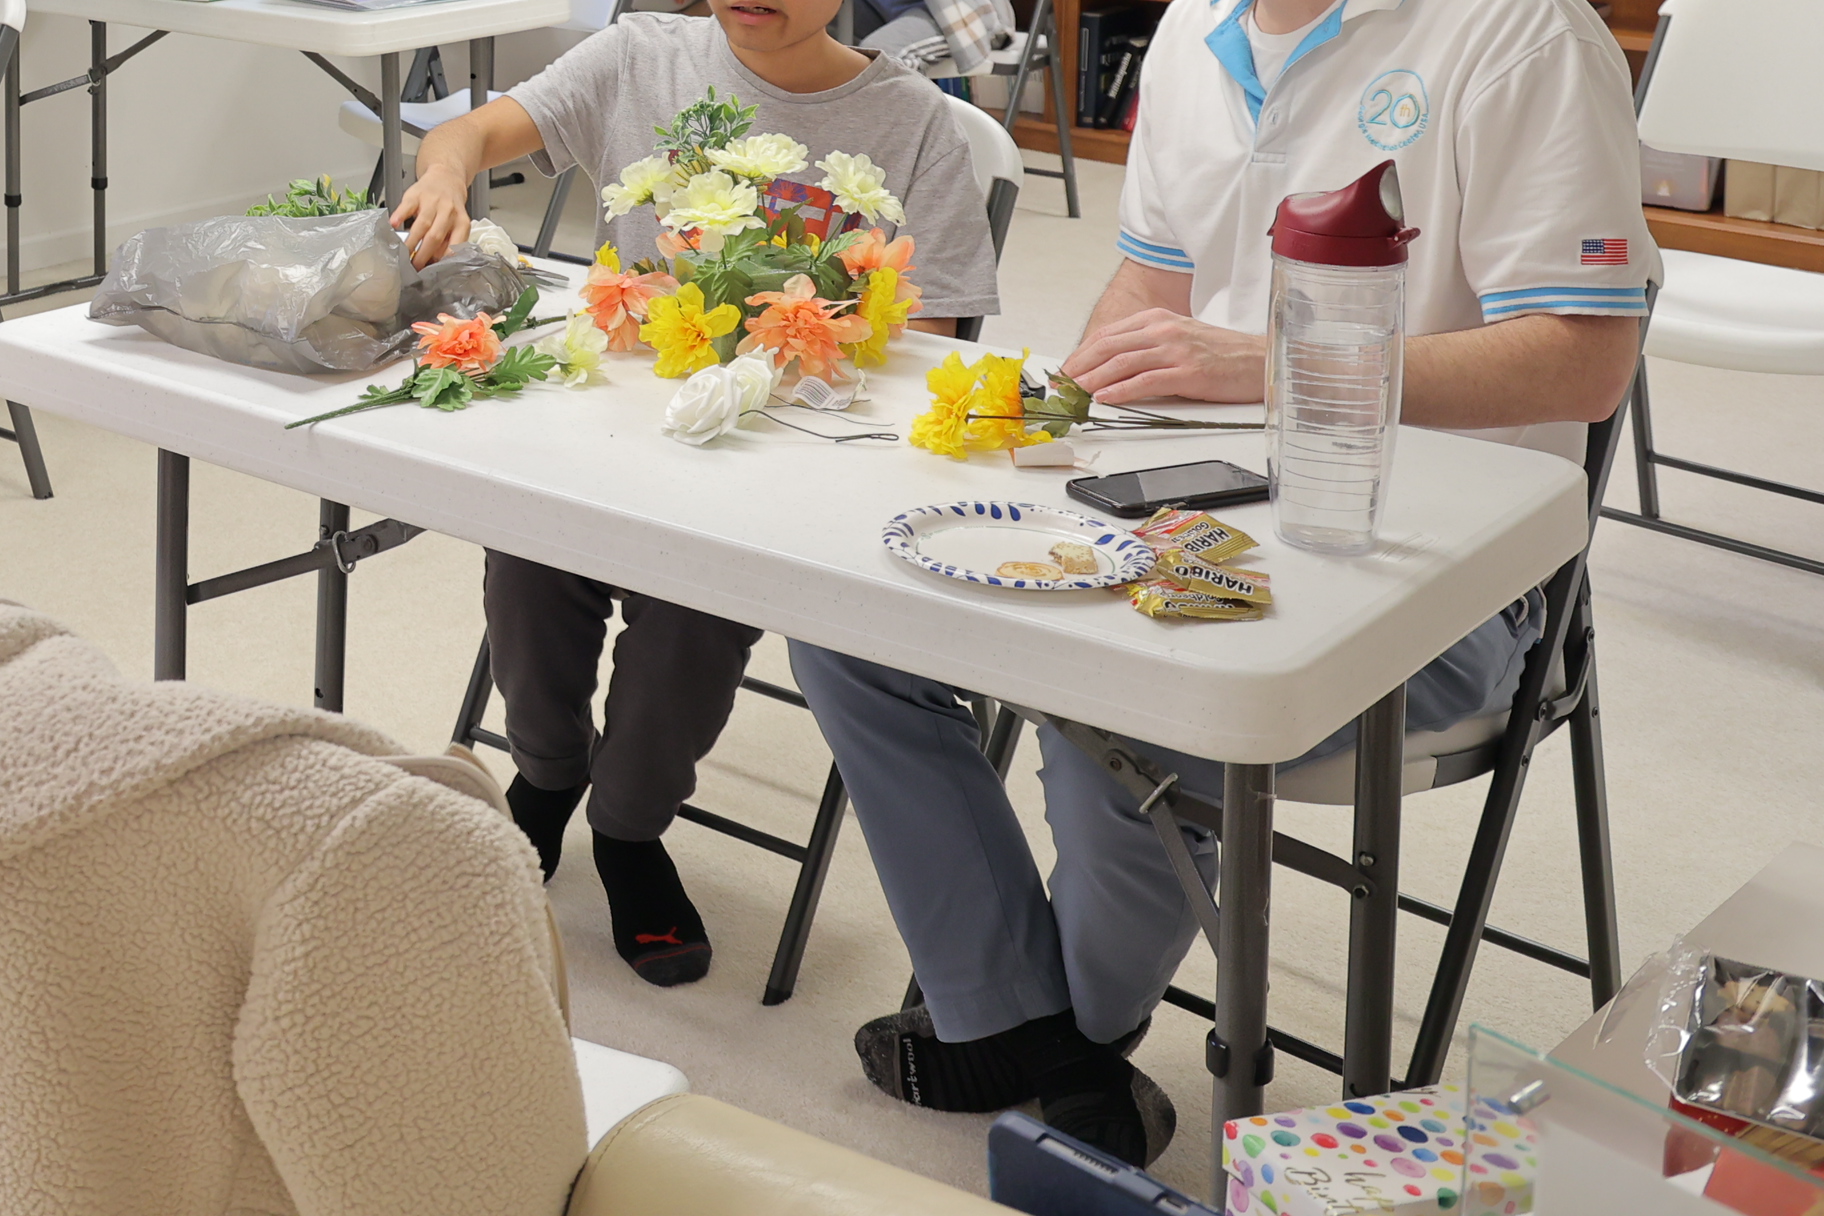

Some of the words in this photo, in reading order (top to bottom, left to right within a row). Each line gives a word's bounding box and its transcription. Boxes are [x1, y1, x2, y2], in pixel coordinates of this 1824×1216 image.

[1184, 528, 1230, 553] HARIB
[1174, 565, 1253, 595] HARIBO
[902, 1037, 922, 1105] artwool
